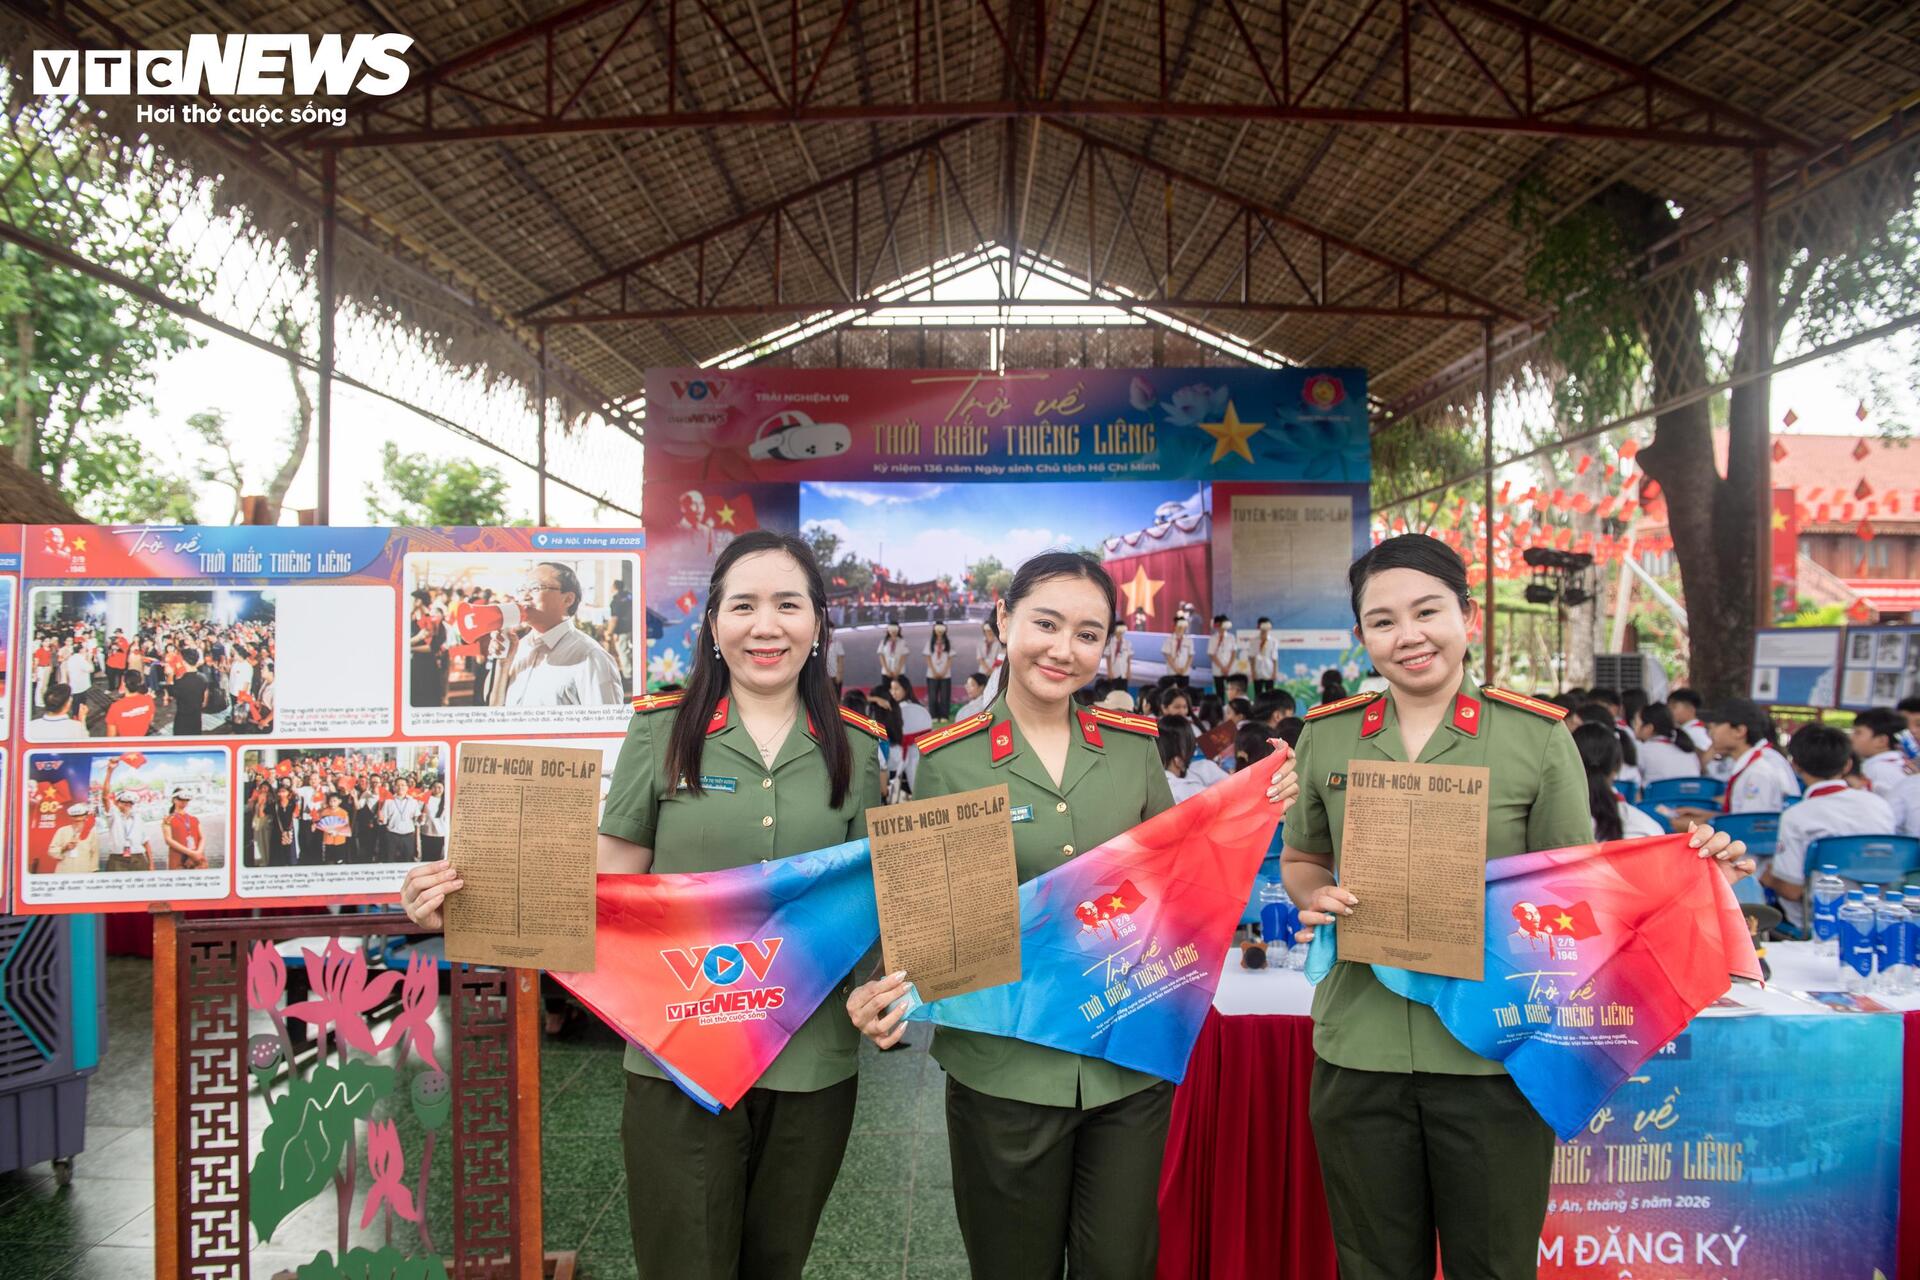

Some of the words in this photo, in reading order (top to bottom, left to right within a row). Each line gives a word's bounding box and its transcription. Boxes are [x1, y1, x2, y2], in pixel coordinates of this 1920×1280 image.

[670, 381, 727, 401] VOV
[911, 373, 1049, 423] Trở
[1033, 381, 1086, 417] về
[873, 418, 921, 455] THỜI
[934, 413, 990, 456] KHẮC
[1003, 419, 1081, 456] THIÊNG
[1094, 418, 1156, 456] LIÊNG
[924, 464, 942, 473] 136
[945, 464, 972, 473] năm
[975, 463, 1005, 475] Ngày
[1008, 463, 1034, 473] sinh
[1130, 461, 1160, 472] Minh
[112, 526, 185, 557] Trở
[174, 533, 202, 554] về
[199, 548, 226, 573] THỜI
[232, 545, 263, 573] KHẮC
[270, 549, 312, 574] THIÊNG
[317, 549, 352, 574] LIÊNG
[1115, 913, 1131, 927] 2/9
[1119, 923, 1137, 938] 1945
[1557, 950, 1578, 961] 1945
[1558, 937, 1576, 948] 2/9
[660, 937, 784, 991] VOV
[1082, 939, 1142, 989] Trở
[1078, 994, 1106, 1022] THỜI
[1104, 978, 1132, 1008] KHẮC
[1131, 959, 1169, 991] THIÊNG
[1168, 942, 1199, 972] LIÊNG
[1505, 970, 1578, 1003] Trở
[1568, 977, 1597, 1001] về
[1492, 1002, 1522, 1028] THỜI
[1524, 997, 1552, 1025] KHẮC
[1556, 1003, 1594, 1028] THIÊNG
[1600, 1001, 1634, 1027] LIÊNG
[1633, 1086, 1681, 1132] về
[1551, 1139, 1592, 1185] HẮC
[1605, 1137, 1673, 1184] THIÊNG
[1684, 1133, 1745, 1182] LIÊNG
[1560, 1199, 1583, 1214] An,
[1587, 1198, 1628, 1213] tháng
[1631, 1197, 1639, 1210] 5
[1642, 1196, 1672, 1209] năm
[1675, 1195, 1712, 1209] 2026
[1574, 1225, 1685, 1267] ĐĂNG
[1696, 1225, 1749, 1267] KÝ
